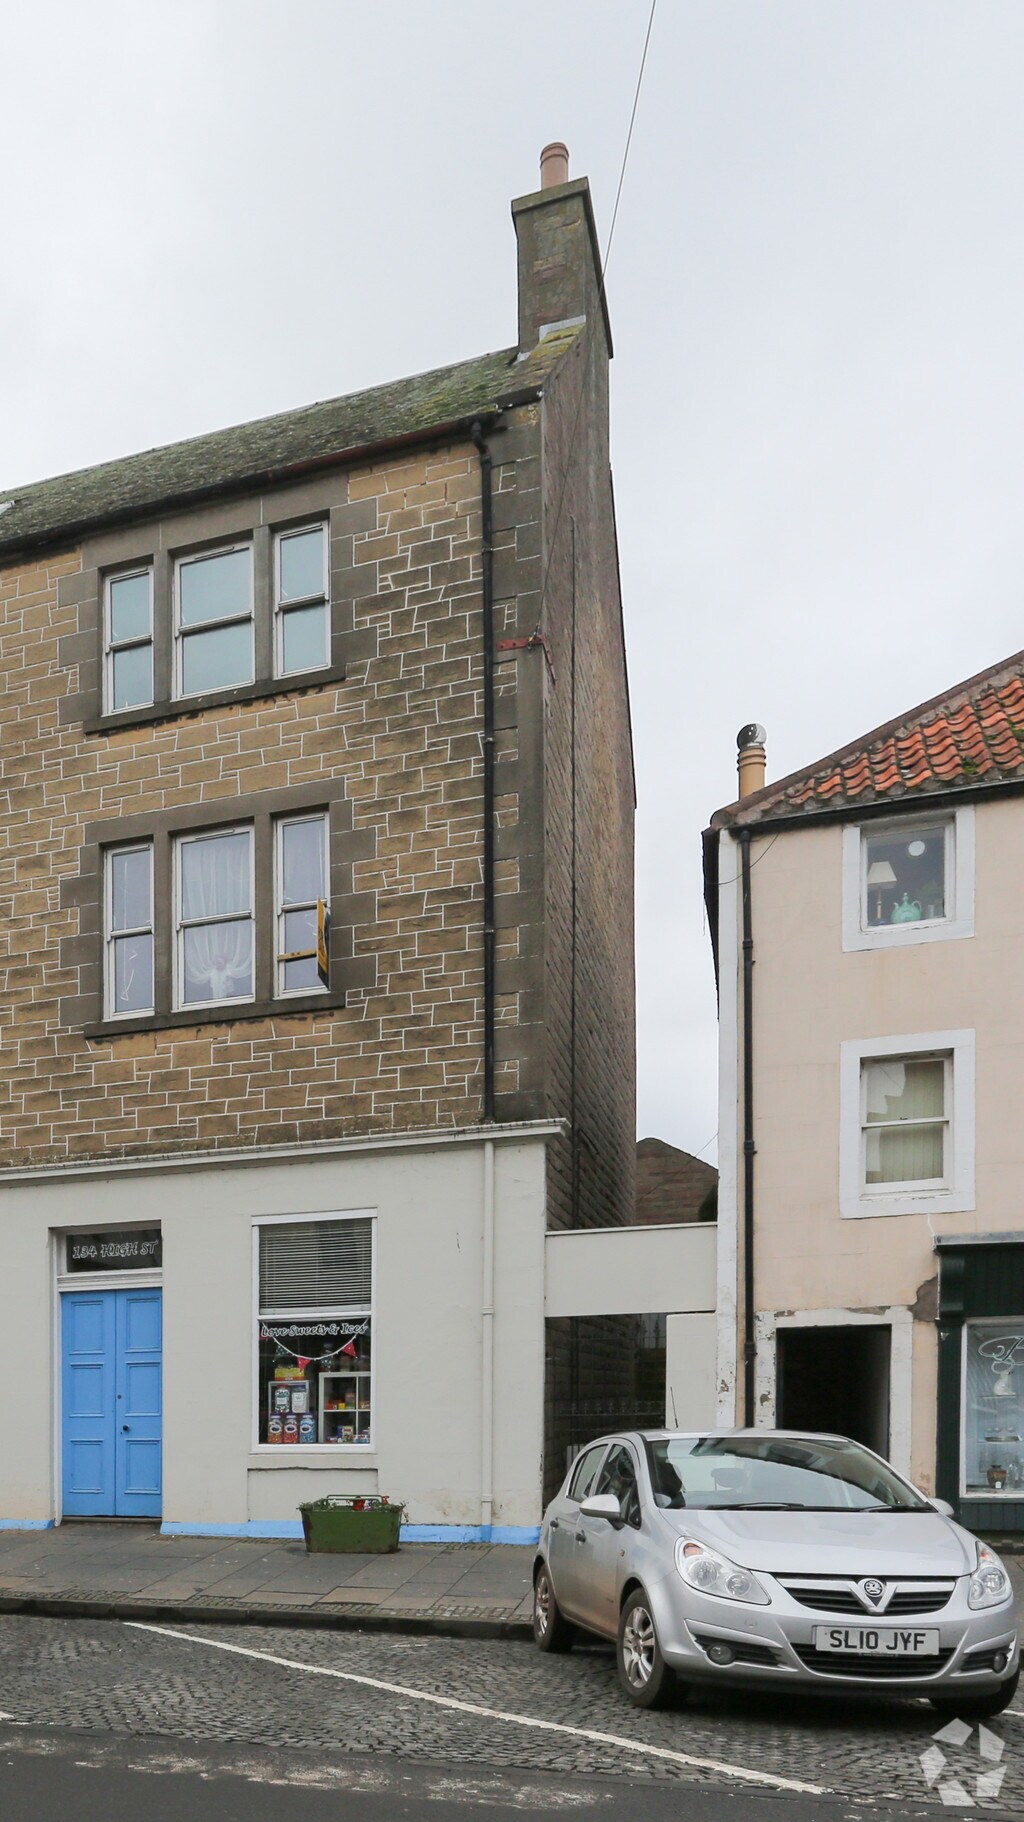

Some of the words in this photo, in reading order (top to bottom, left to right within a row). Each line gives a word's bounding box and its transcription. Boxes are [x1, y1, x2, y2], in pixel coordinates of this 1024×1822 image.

[72, 1245, 97, 1259] 134
[100, 1241, 138, 1257] HIGH
[140, 1240, 158, 1255] ST
[261, 1325, 289, 1337] Love
[289, 1323, 327, 1336] Sweets
[328, 1323, 339, 1335] &
[340, 1322, 370, 1334] Ices
[829, 1629, 879, 1650] SL10
[885, 1632, 926, 1651] JYF
